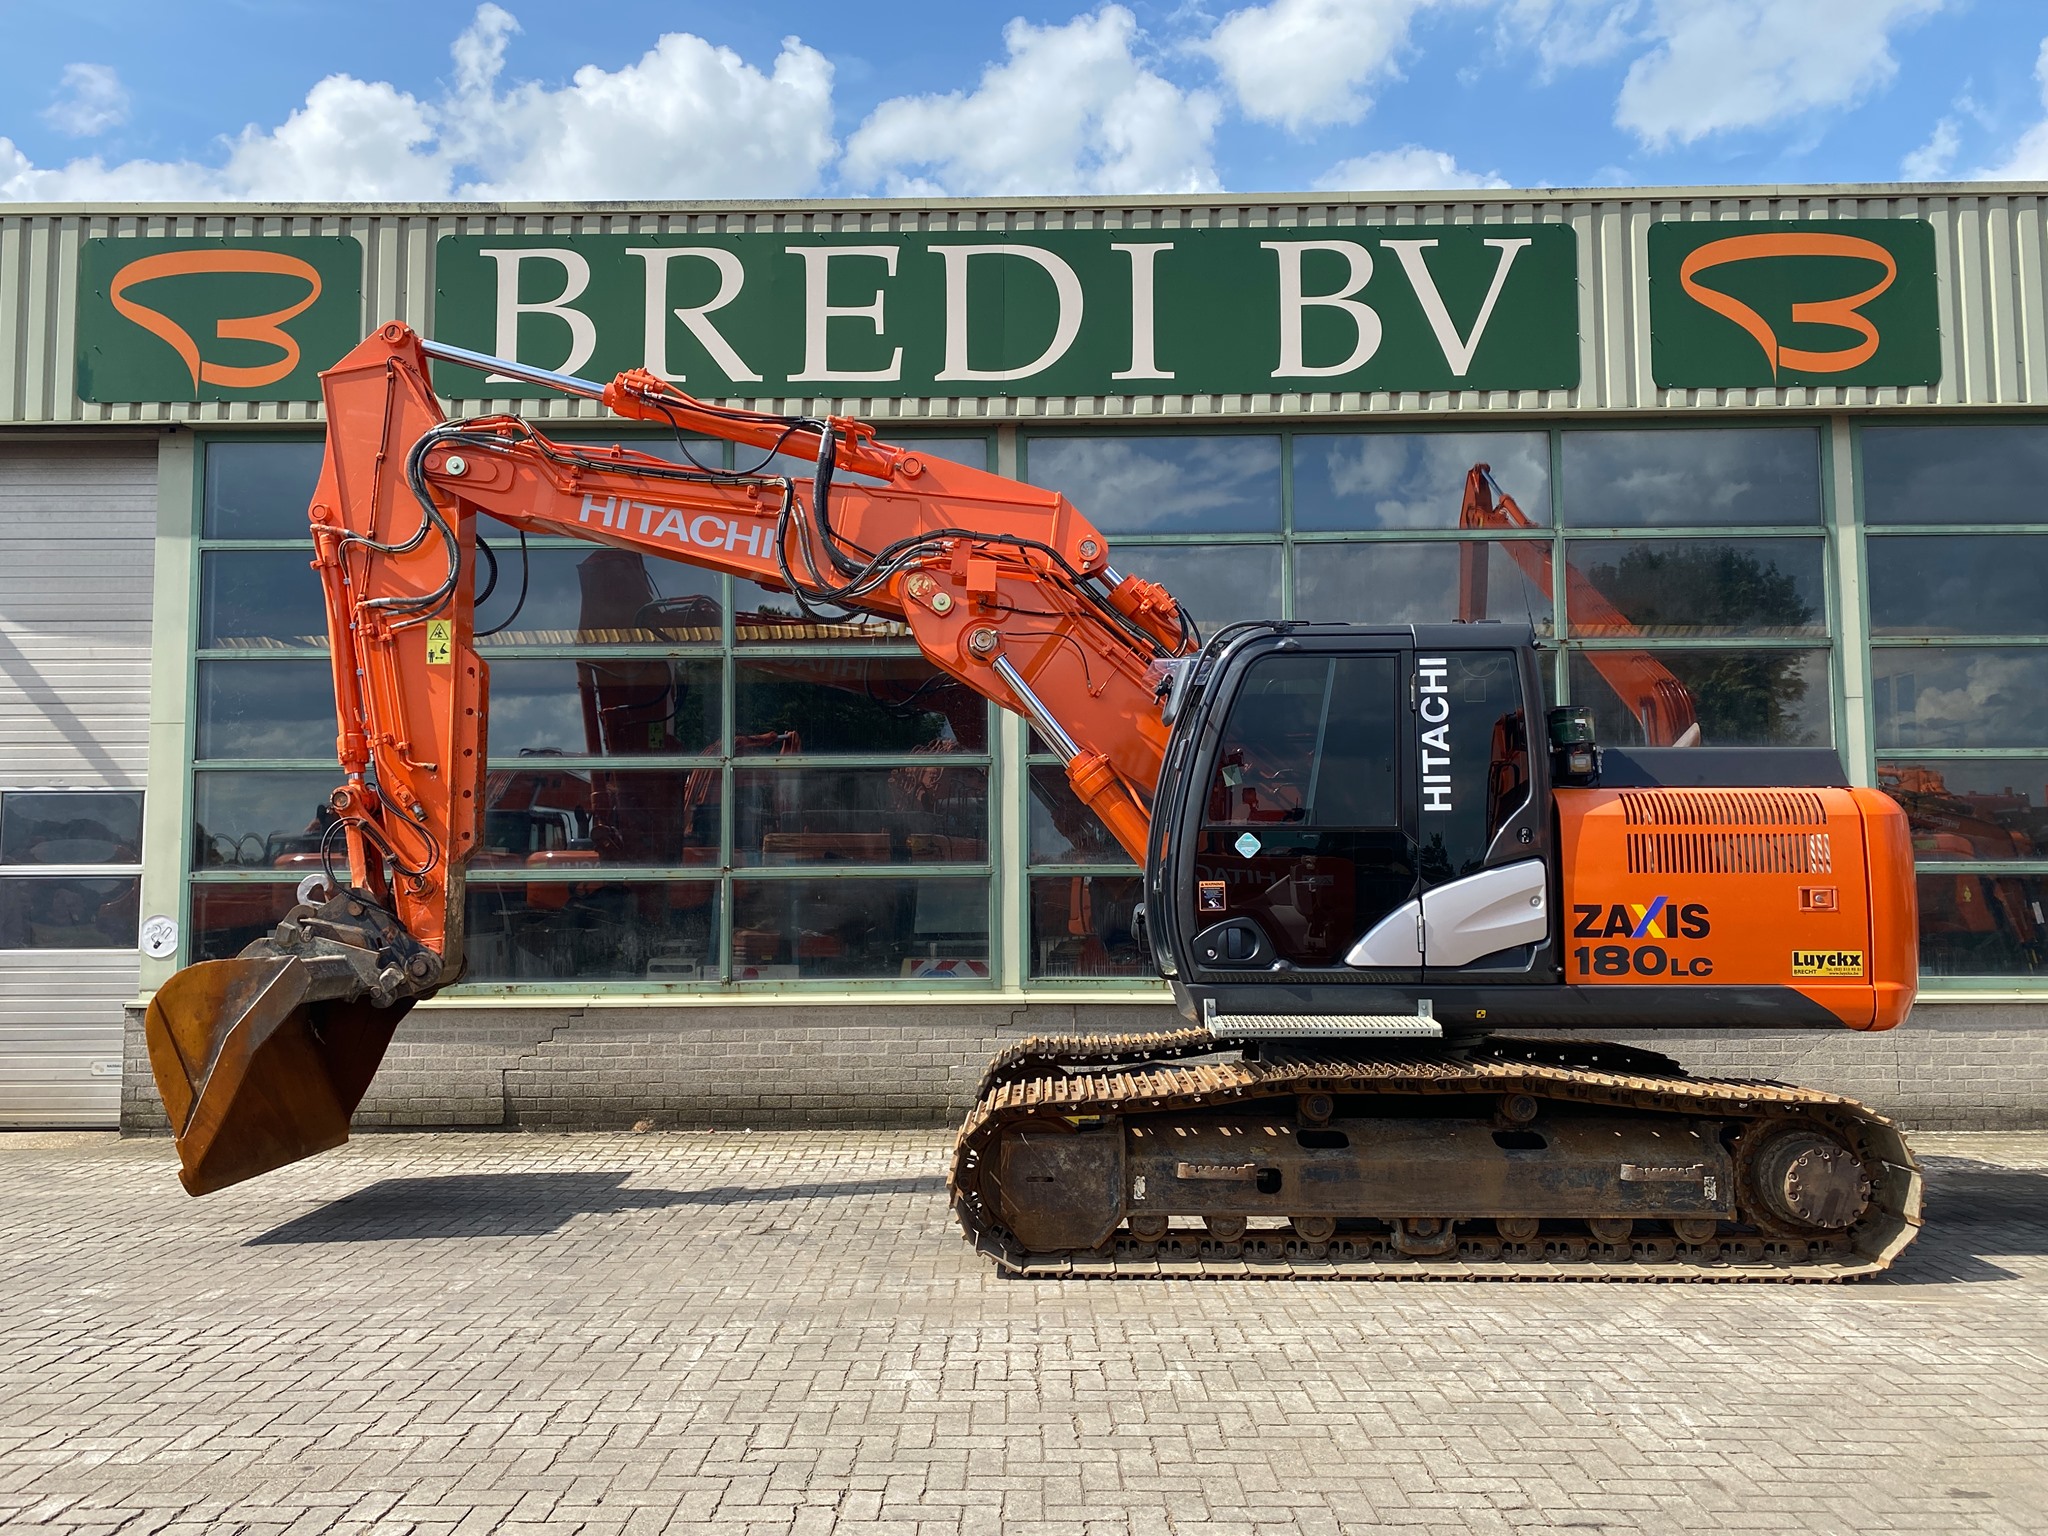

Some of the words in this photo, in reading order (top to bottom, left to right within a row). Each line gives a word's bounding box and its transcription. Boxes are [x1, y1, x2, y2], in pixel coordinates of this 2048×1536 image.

[479, 242, 1176, 385] BREDI
[1260, 237, 1533, 377] BV
[579, 494, 775, 559] HITACHI
[1419, 658, 1452, 812] HITACHI
[1573, 895, 1711, 939] ZAXIS
[1793, 951, 1862, 970] Luyckx
